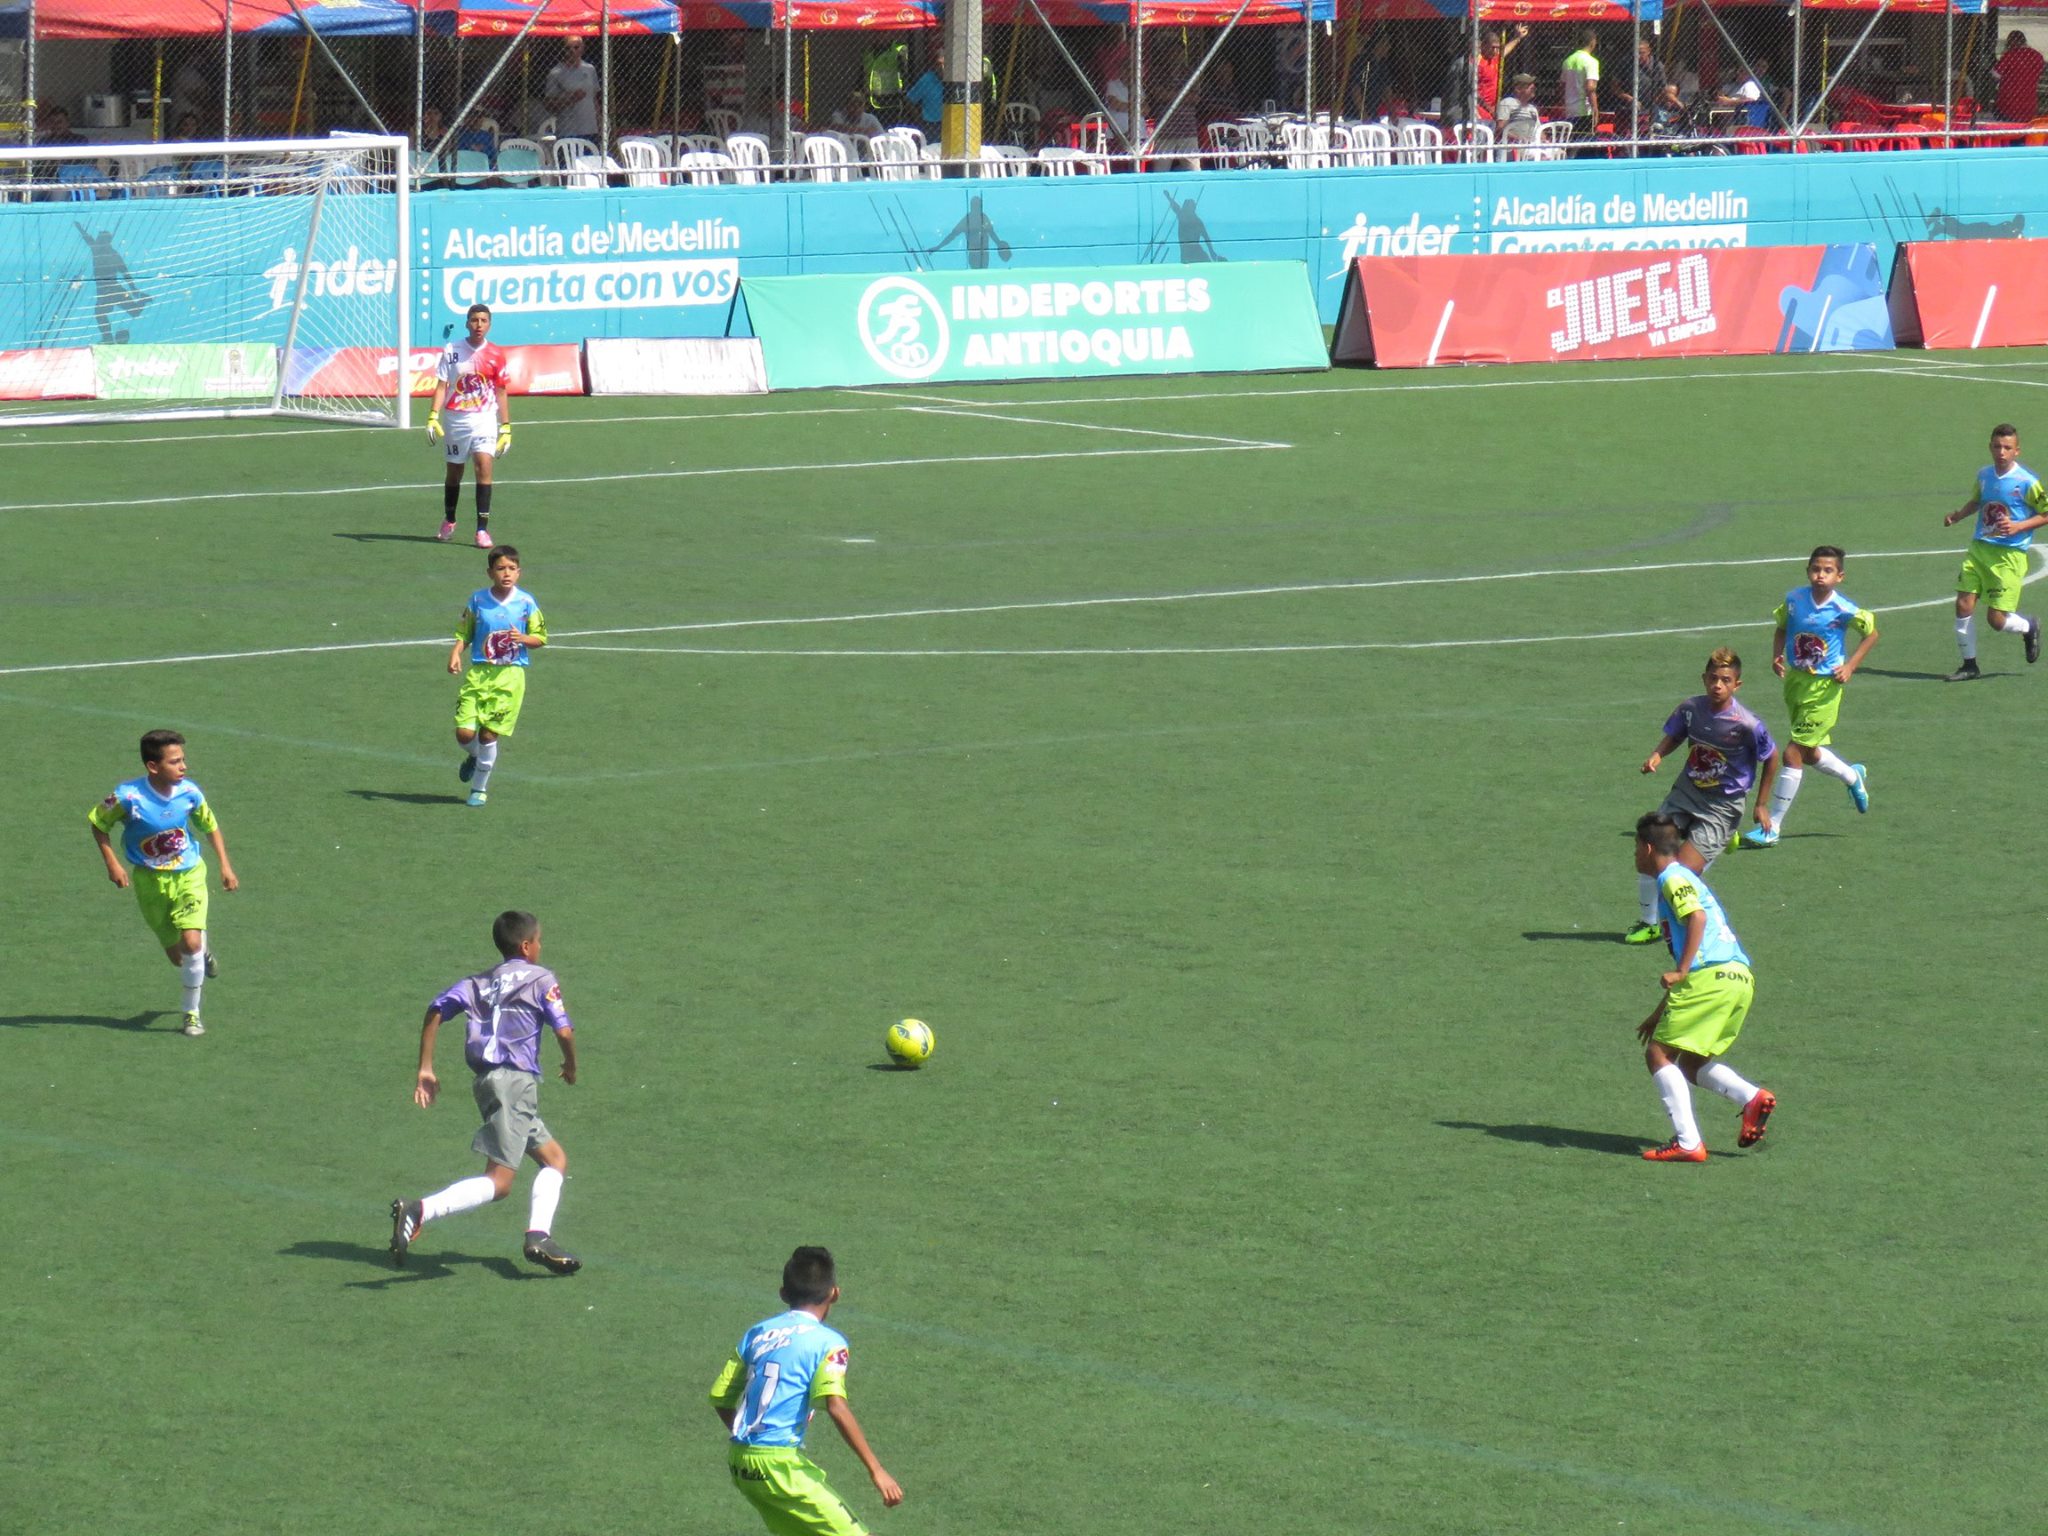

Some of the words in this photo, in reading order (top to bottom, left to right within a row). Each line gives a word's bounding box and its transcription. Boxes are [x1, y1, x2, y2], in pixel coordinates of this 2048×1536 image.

[1491, 194, 1597, 226] Alcaldía
[1602, 194, 1636, 224] de
[1642, 189, 1748, 223] Medellín
[443, 224, 564, 260] Alcaldía
[571, 223, 610, 255] de
[614, 217, 740, 254] Medellín
[450, 269, 586, 307] Cuenta
[594, 270, 663, 302] con
[672, 268, 732, 299] vos
[952, 277, 1212, 321] INDEPORTES
[1551, 253, 1712, 353] JUEGO
[963, 326, 1194, 367] ANTIOQUIA
[1714, 971, 1750, 985] PONY
